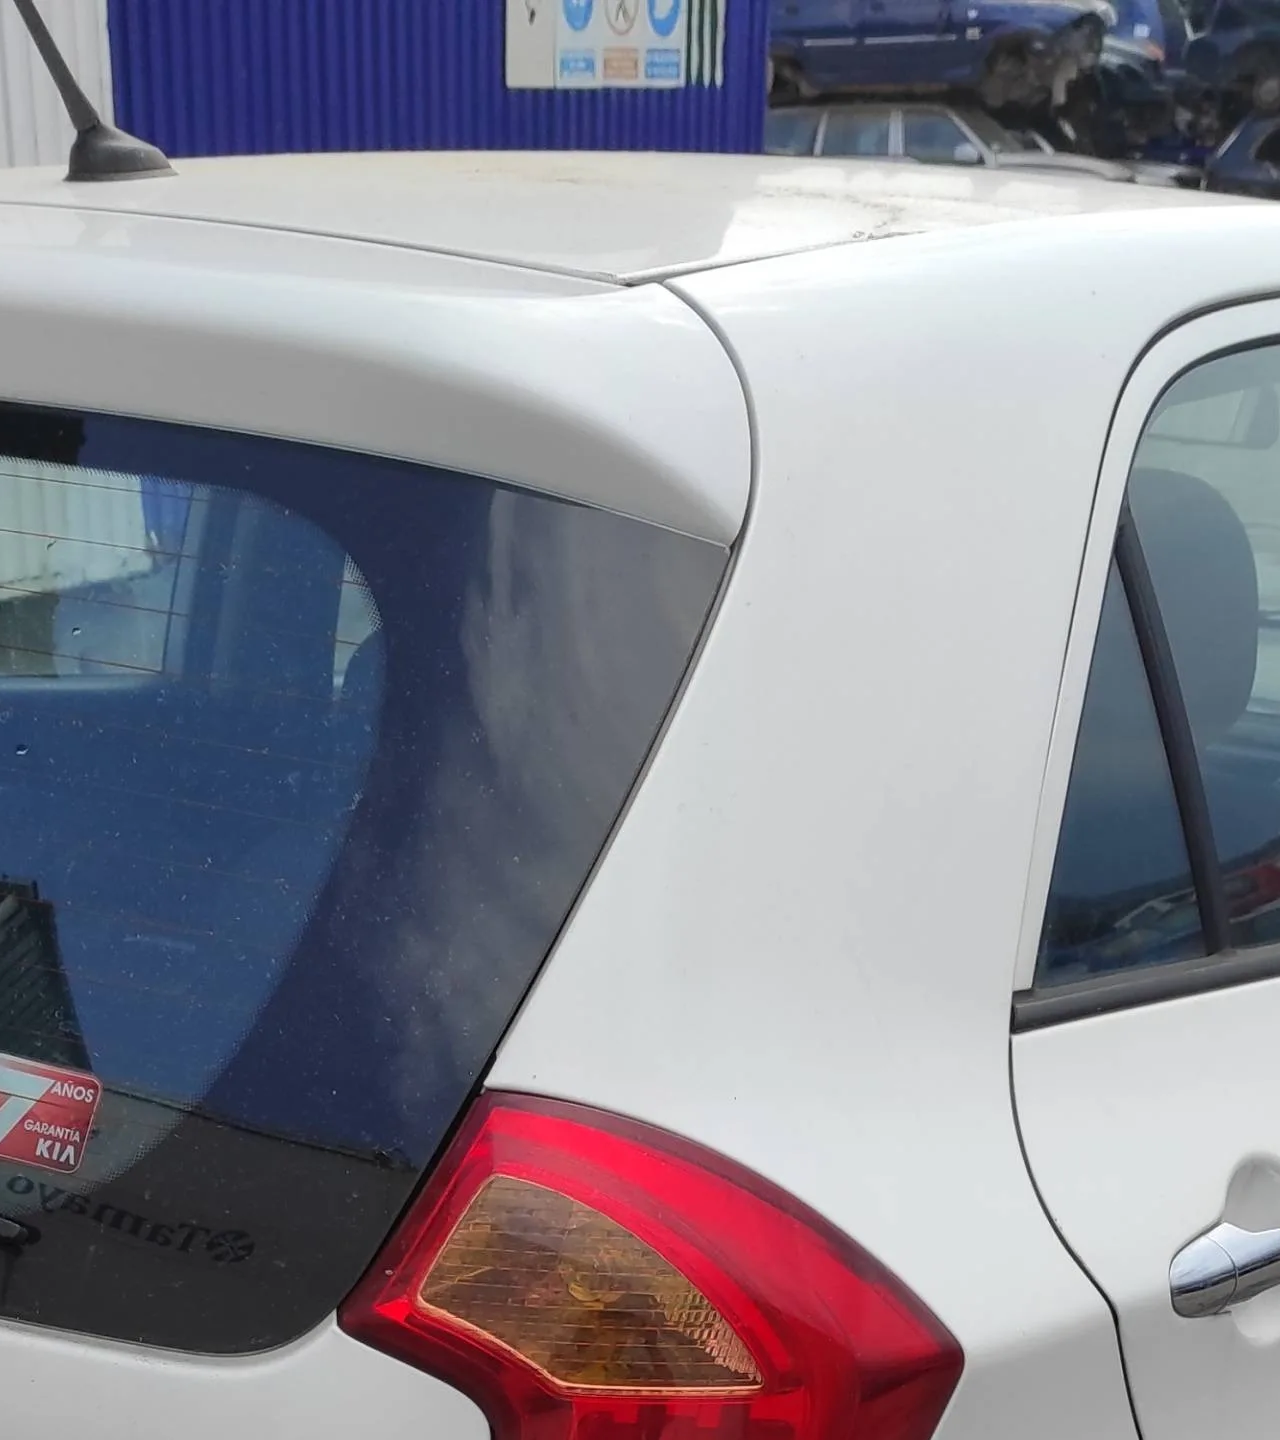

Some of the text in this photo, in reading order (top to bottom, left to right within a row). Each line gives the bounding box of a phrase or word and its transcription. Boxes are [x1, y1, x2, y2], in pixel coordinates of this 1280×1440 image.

[51, 1079, 95, 1103] AÑOS
[23, 1118, 81, 1143] GARANTÍA
[35, 1137, 76, 1166] KIA
